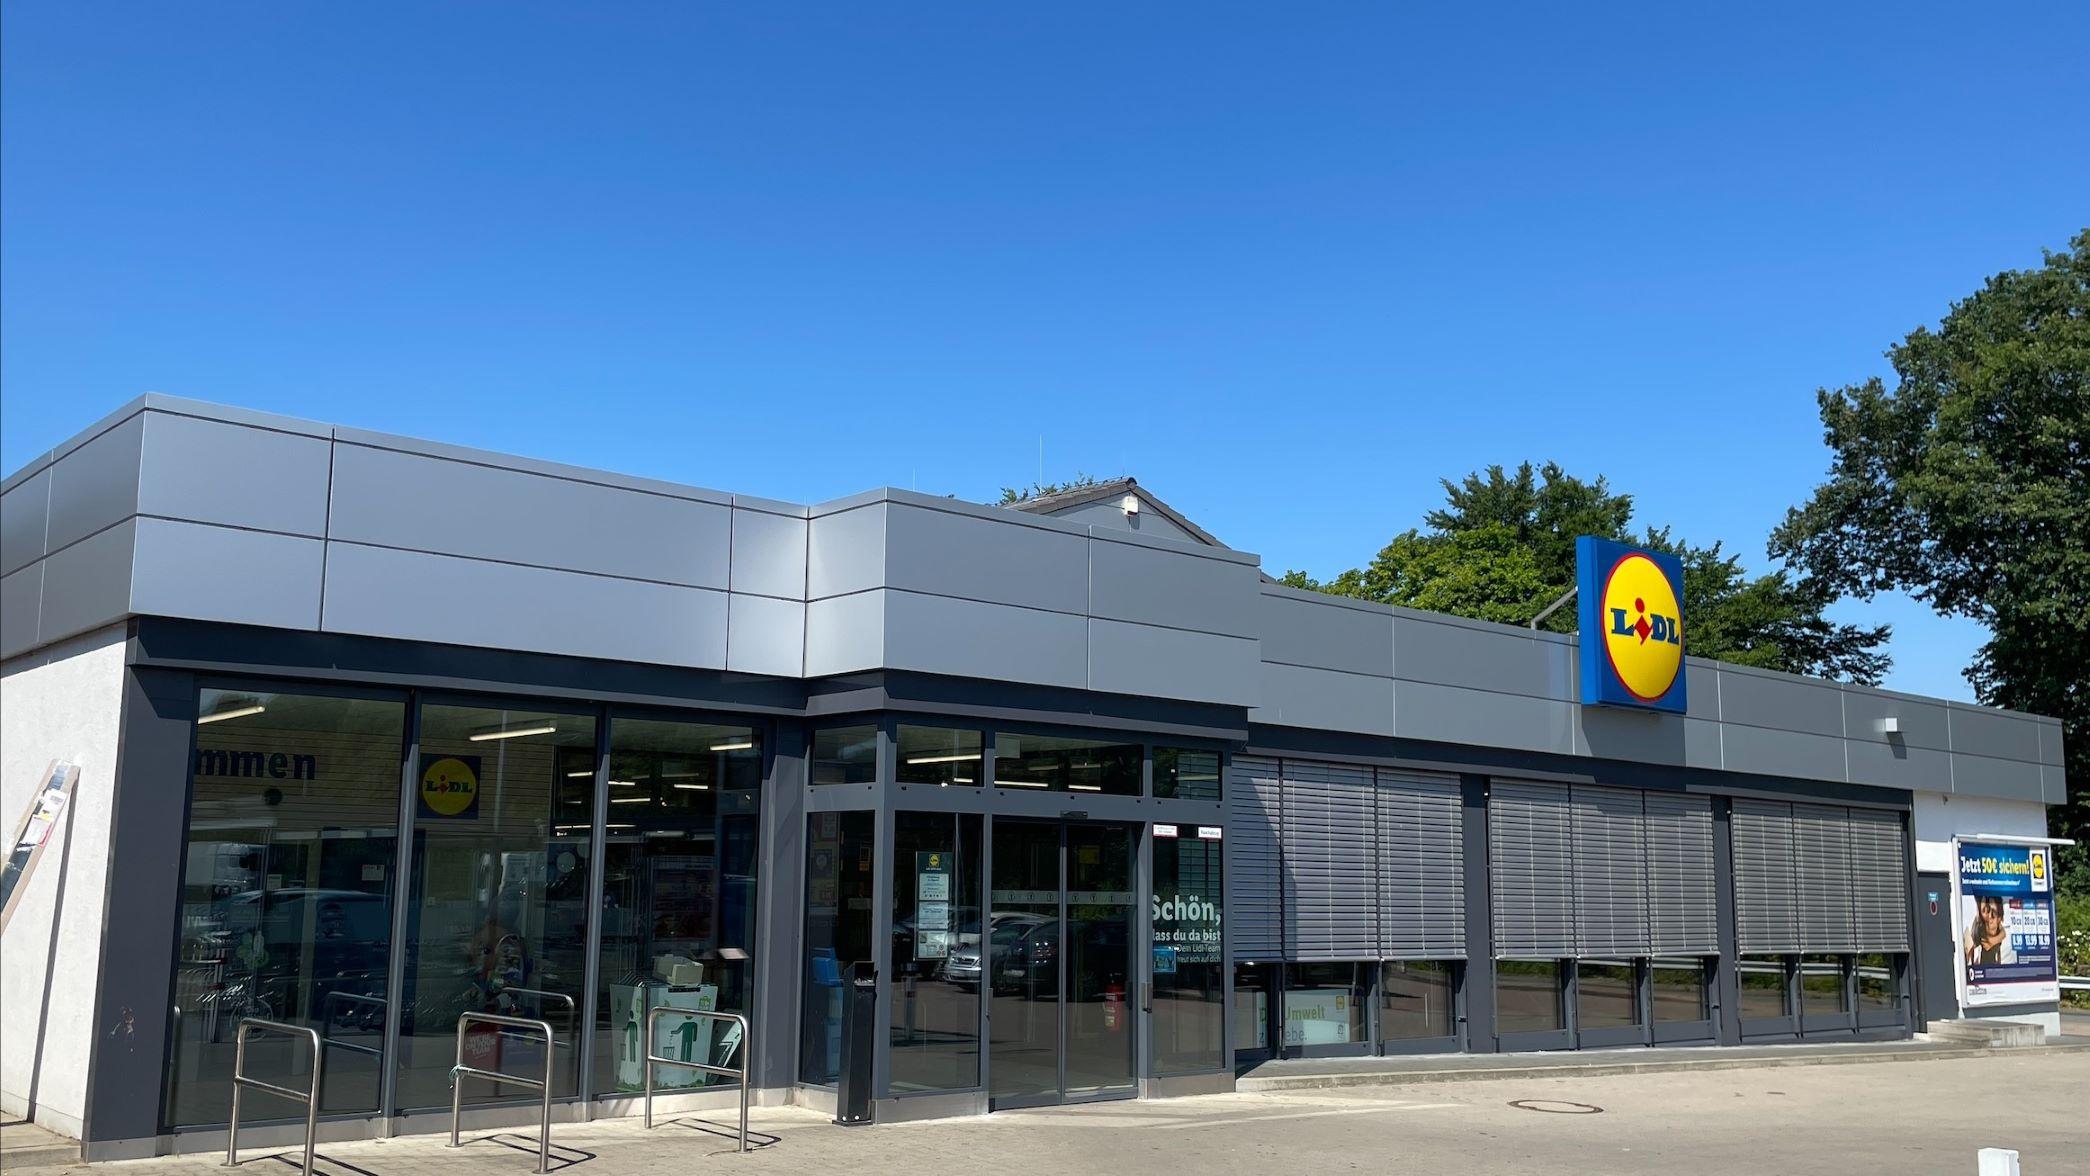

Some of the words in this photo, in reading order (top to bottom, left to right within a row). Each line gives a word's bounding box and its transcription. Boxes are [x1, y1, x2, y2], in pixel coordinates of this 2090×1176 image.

[1961, 856, 1981, 873] Jetzt
[1982, 857, 1998, 874] 50€
[1999, 857, 2030, 875] sichern!
[1152, 894, 1221, 926] Schön,
[1173, 929, 1186, 941] du
[1189, 929, 1201, 941] da
[1203, 929, 1221, 941] bist
